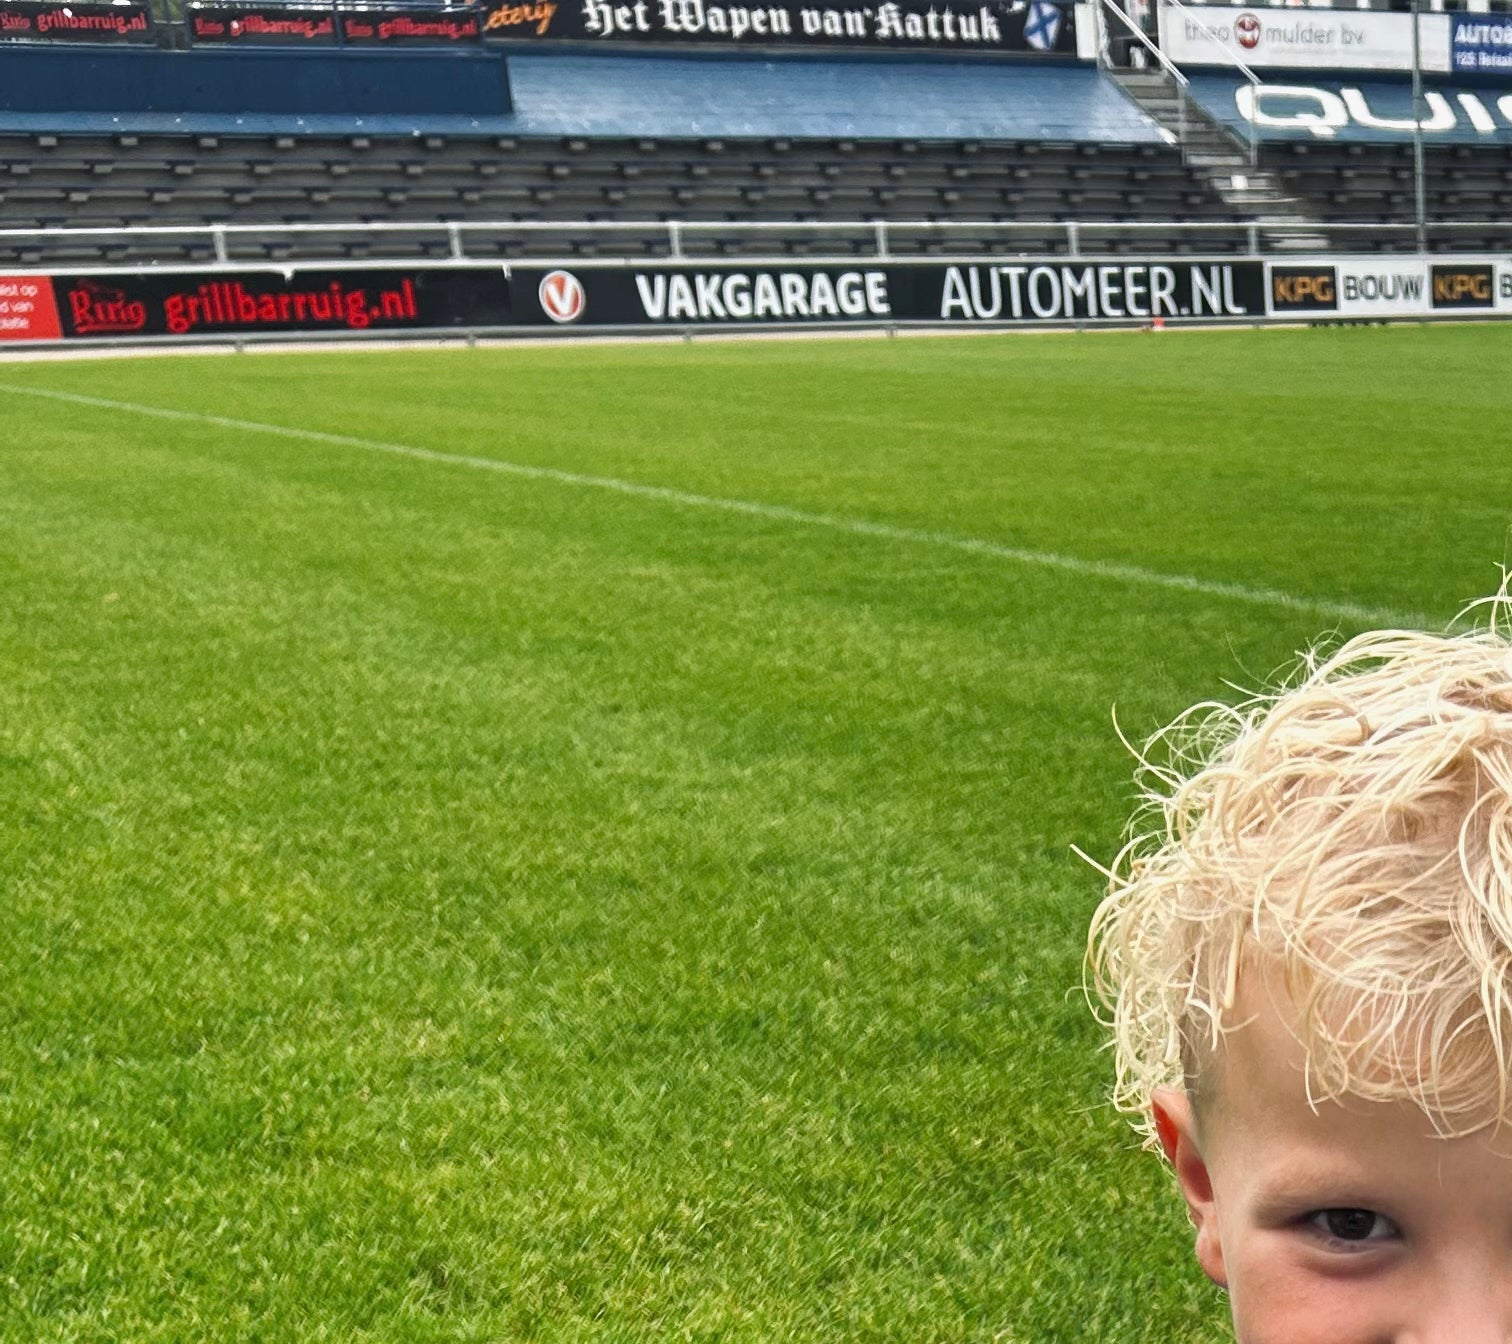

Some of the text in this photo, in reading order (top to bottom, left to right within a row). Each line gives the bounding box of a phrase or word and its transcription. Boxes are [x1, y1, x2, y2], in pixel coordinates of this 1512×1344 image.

[583, 0, 650, 36] Het
[659, 0, 792, 39] Wapen
[801, 8, 867, 36] van
[164, 278, 417, 334] grillbarruig.nl
[635, 265, 1247, 319] VAKGARAGE AUTOMEER.NL
[1272, 275, 1424, 302] KPG BOUW
[1431, 274, 1491, 300] KPG
